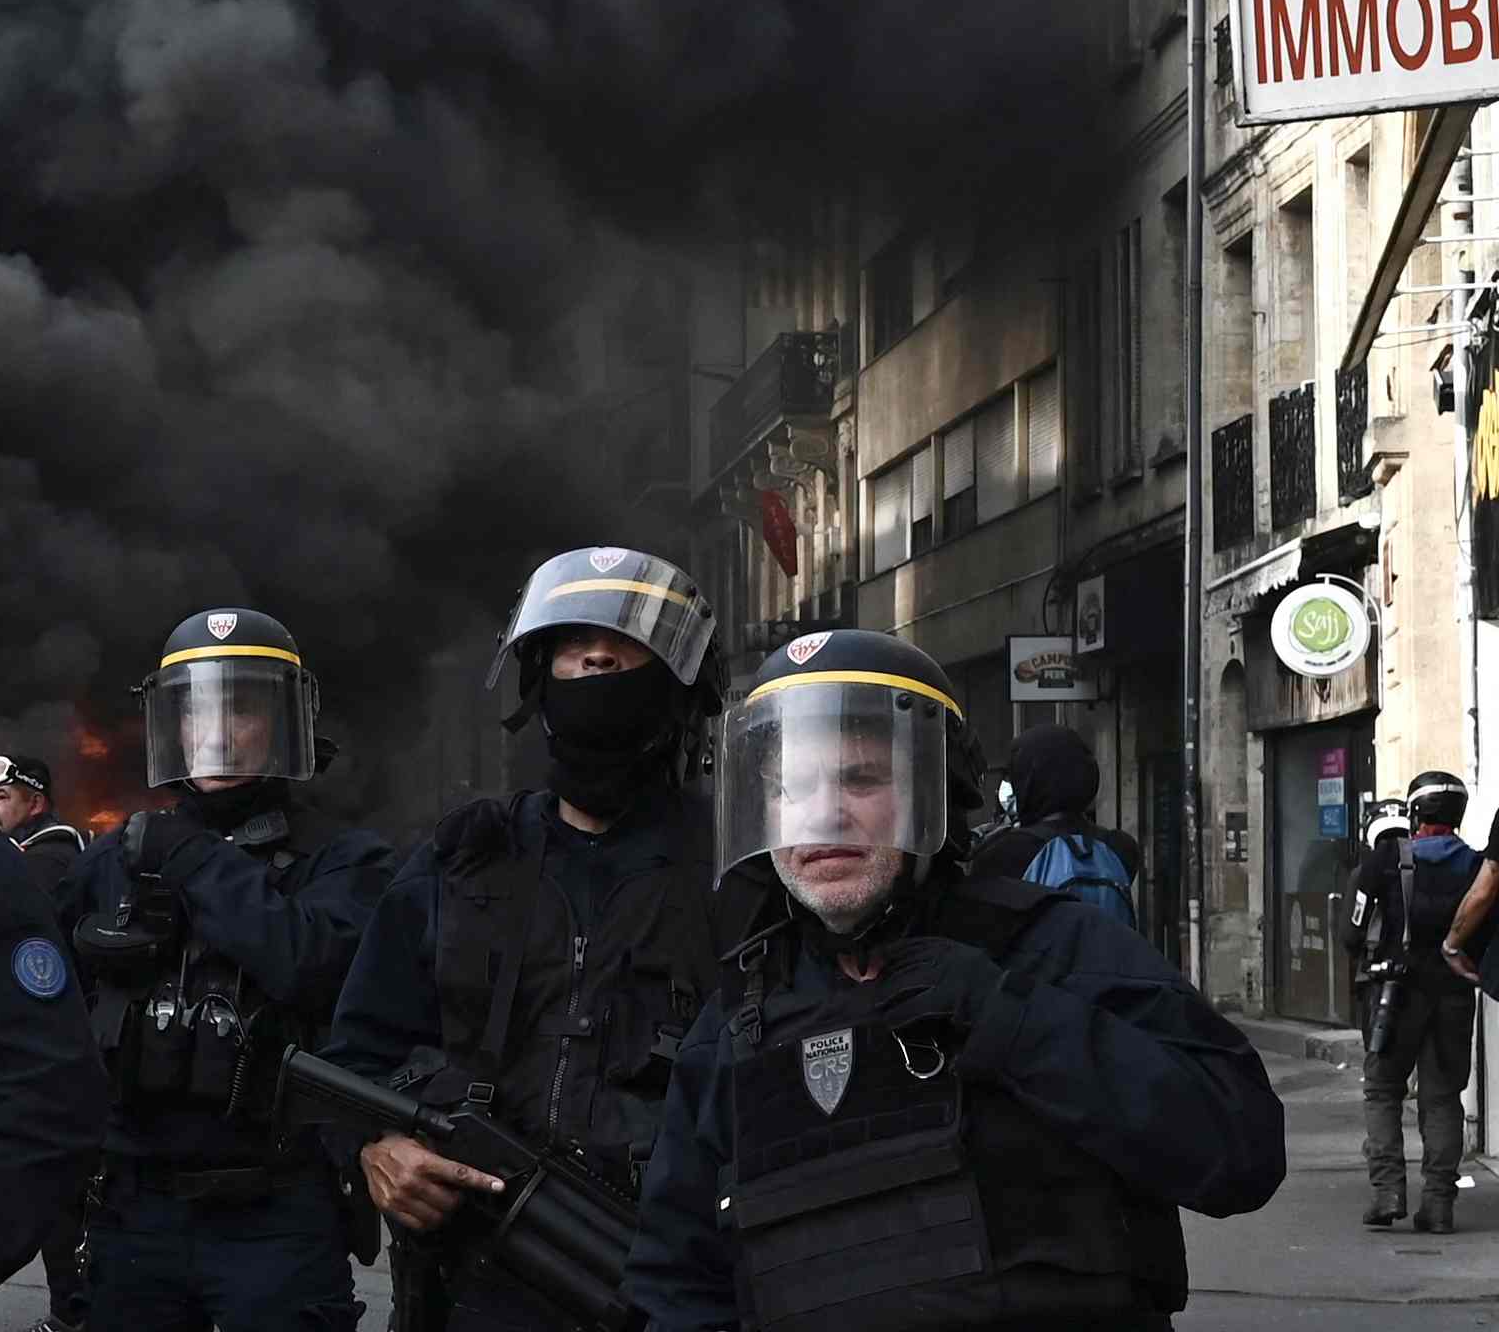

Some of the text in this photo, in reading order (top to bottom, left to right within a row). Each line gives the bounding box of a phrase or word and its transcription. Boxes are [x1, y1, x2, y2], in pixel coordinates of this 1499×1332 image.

[1298, 608, 1340, 646] Sajj
[810, 1035, 844, 1051] POLICE
[809, 1054, 851, 1080] CRS
